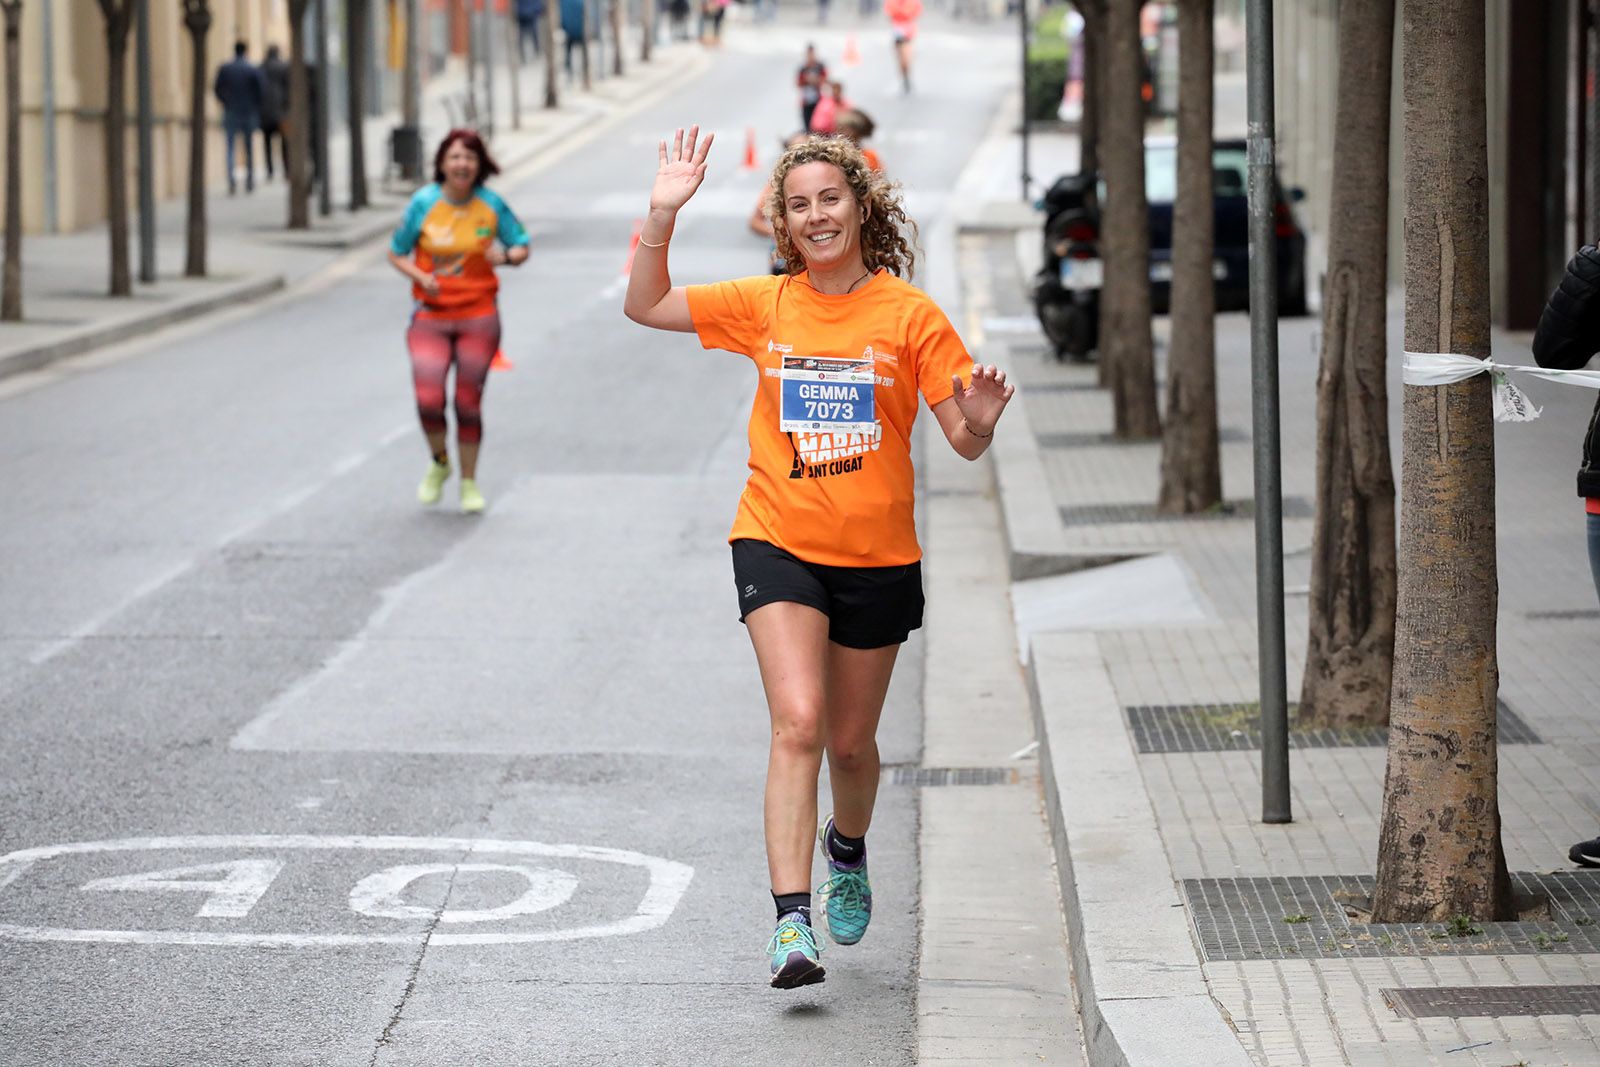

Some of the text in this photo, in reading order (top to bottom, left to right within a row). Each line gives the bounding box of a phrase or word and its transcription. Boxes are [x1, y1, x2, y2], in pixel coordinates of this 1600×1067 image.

[799, 384, 860, 401] GEMMA
[805, 401, 855, 420] 7073
[829, 456, 863, 475] CUGAT
[81, 858, 578, 923] 40
